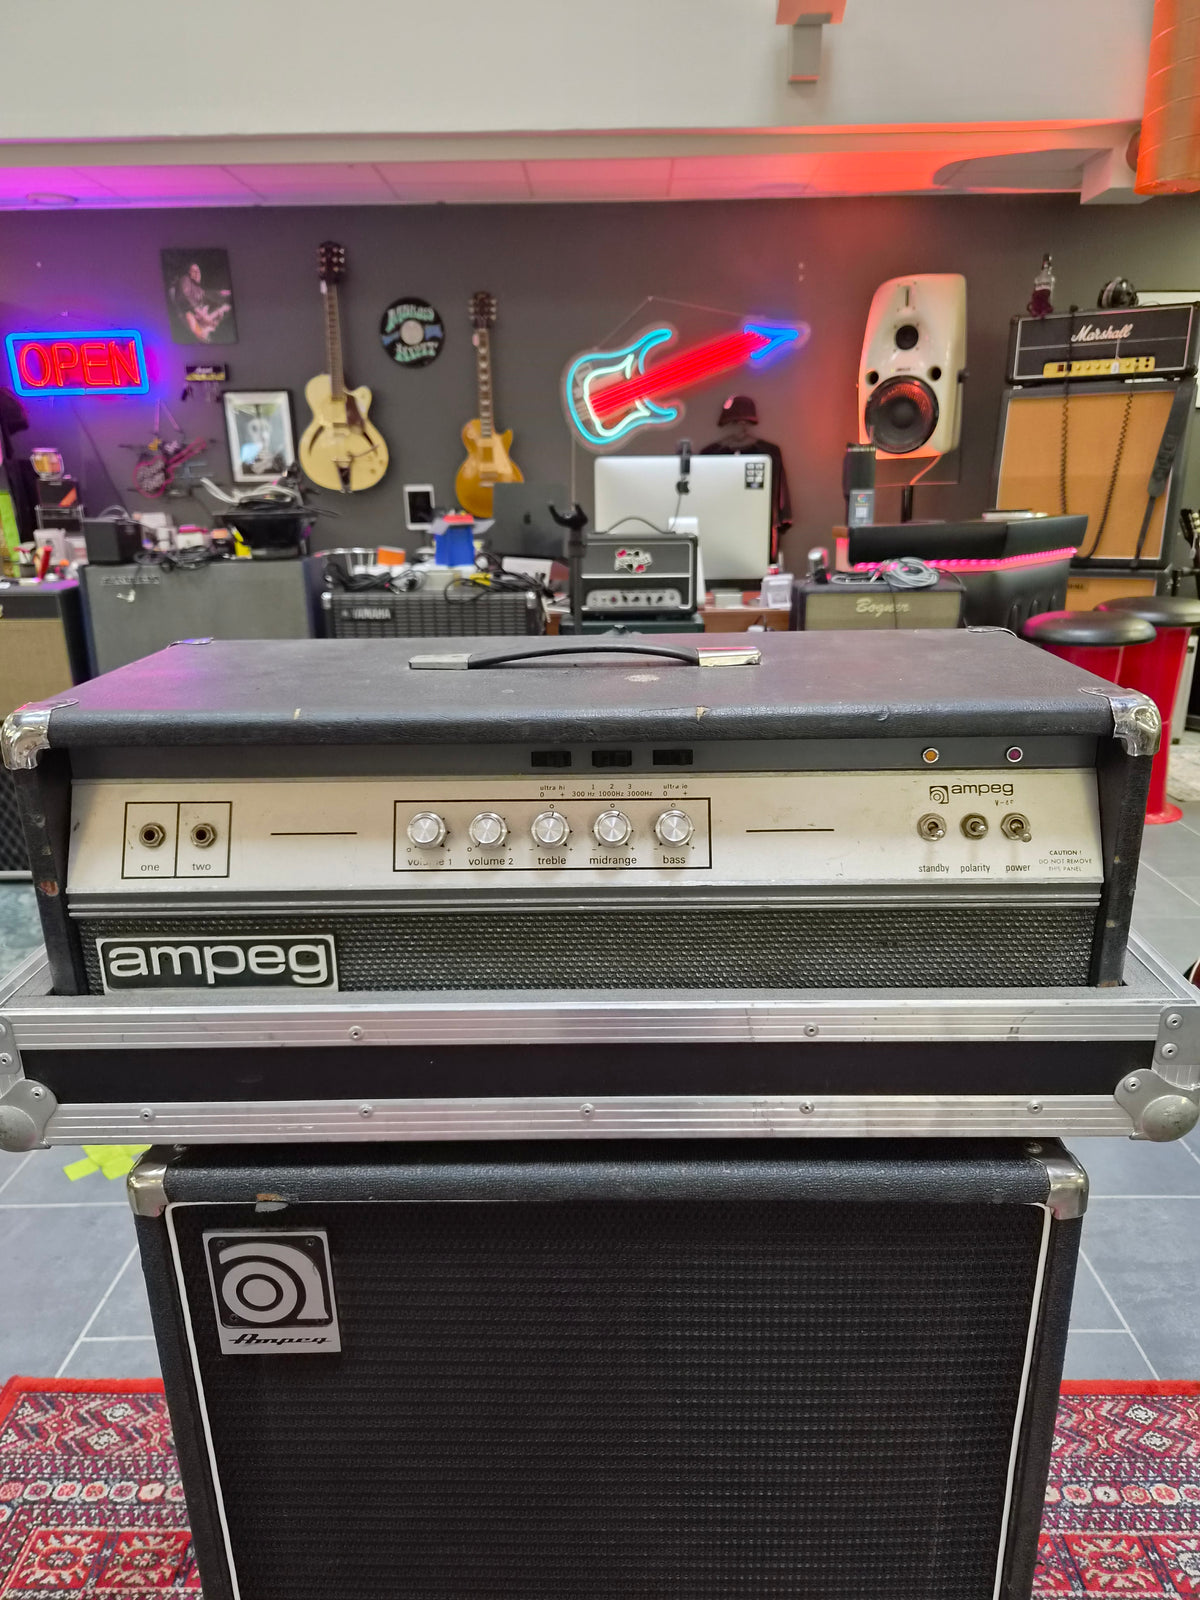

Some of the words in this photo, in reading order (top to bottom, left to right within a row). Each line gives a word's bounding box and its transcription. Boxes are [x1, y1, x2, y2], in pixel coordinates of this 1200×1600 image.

[1070, 323, 1133, 342] Marshall
[19, 340, 140, 387] OPEN
[855, 597, 910, 618] Bogner
[351, 607, 391, 620] YAMAHA
[951, 783, 1014, 797] ampeg
[469, 857, 506, 866] volume
[508, 857, 514, 865] 2
[537, 855, 567, 865] treble
[589, 855, 637, 866] midrange
[662, 855, 686, 864] bass
[140, 863, 160, 872] one
[192, 863, 212, 871] two
[918, 863, 950, 873] standby
[960, 863, 991, 873] polarity
[1005, 864, 1031, 873] power
[109, 944, 328, 984] ampeg
[228, 1333, 331, 1345] Ampeg
